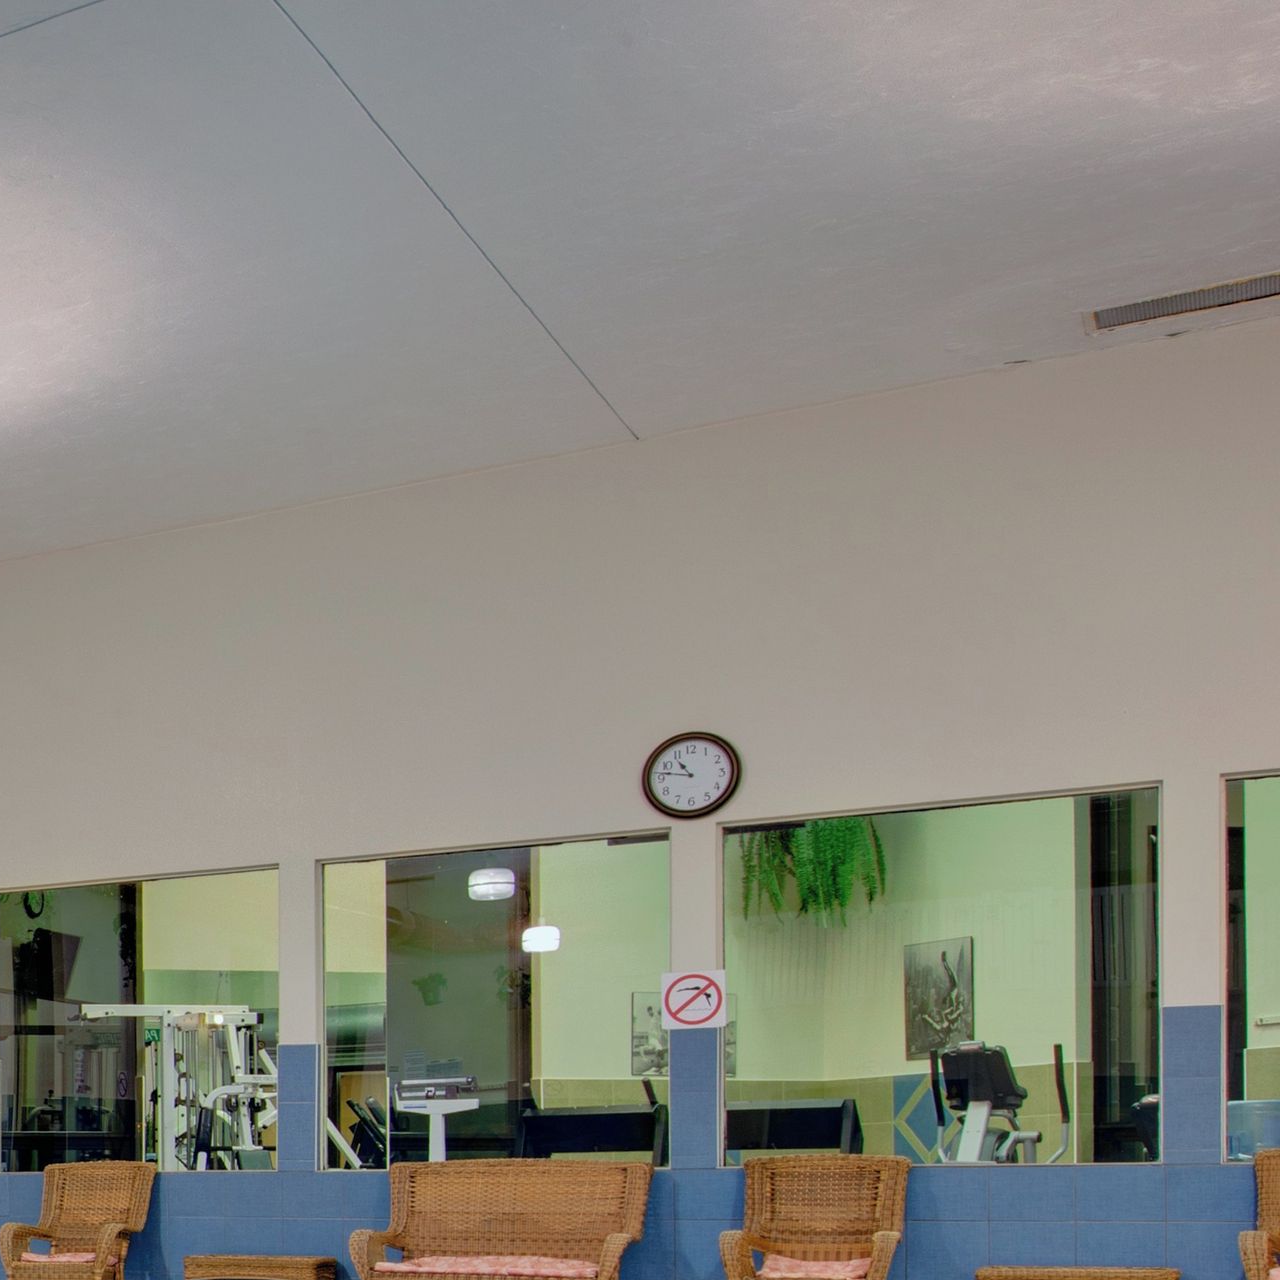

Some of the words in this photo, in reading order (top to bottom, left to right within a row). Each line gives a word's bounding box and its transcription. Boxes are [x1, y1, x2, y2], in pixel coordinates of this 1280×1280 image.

[686, 745, 697, 755] 12
[704, 747, 708, 756] 1
[674, 750, 681, 760] 11
[714, 755, 721, 764] 2
[663, 761, 673, 770] 10
[719, 768, 726, 777] 3
[657, 774, 665, 783] 9
[662, 786, 670, 796] 8
[675, 795, 681, 804] 7
[704, 792, 711, 801] 5
[688, 797, 695, 806] 6
